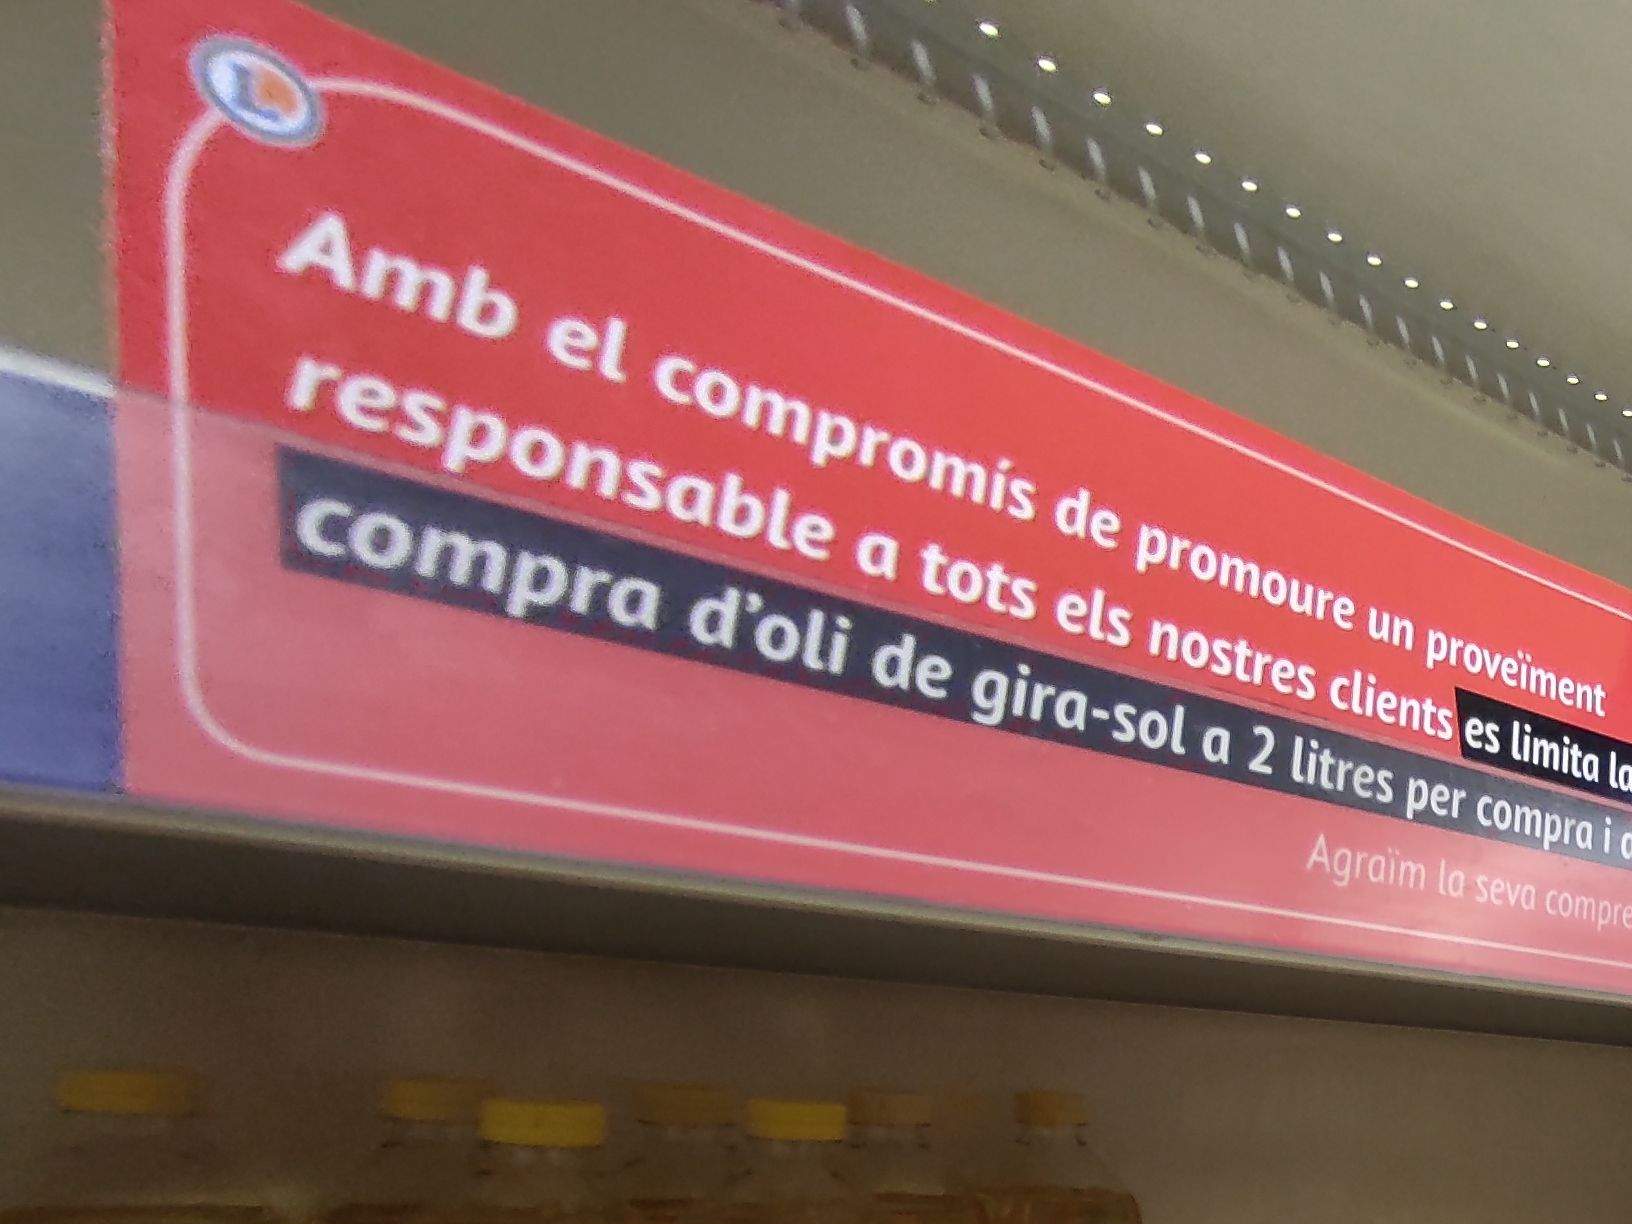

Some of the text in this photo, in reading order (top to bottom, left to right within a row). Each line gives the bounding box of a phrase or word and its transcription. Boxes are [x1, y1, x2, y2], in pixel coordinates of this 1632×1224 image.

[276, 210, 1608, 718] Amb el compromís de promoure un proveïment
[284, 356, 836, 562] responsable
[856, 531, 898, 580] a
[922, 541, 1036, 621] tots
[1056, 586, 1131, 647] els
[1149, 621, 1317, 701] nostres
[1329, 666, 1455, 742] clients
[1464, 719, 1501, 754] es
[1511, 723, 1601, 783] limita
[297, 497, 663, 619] compra
[689, 584, 852, 675] d'oli
[872, 634, 951, 699] de
[972, 663, 1185, 757] gira-sol
[1202, 726, 1231, 764] a
[1248, 726, 1275, 775] 2
[1291, 737, 1395, 804] litres
[1406, 775, 1467, 820] per
[1476, 797, 1594, 853] compra
[1602, 814, 1613, 856] i
[1306, 834, 1427, 892] Agraïm
[1437, 858, 1467, 899] la
[1474, 875, 1537, 913] seva
